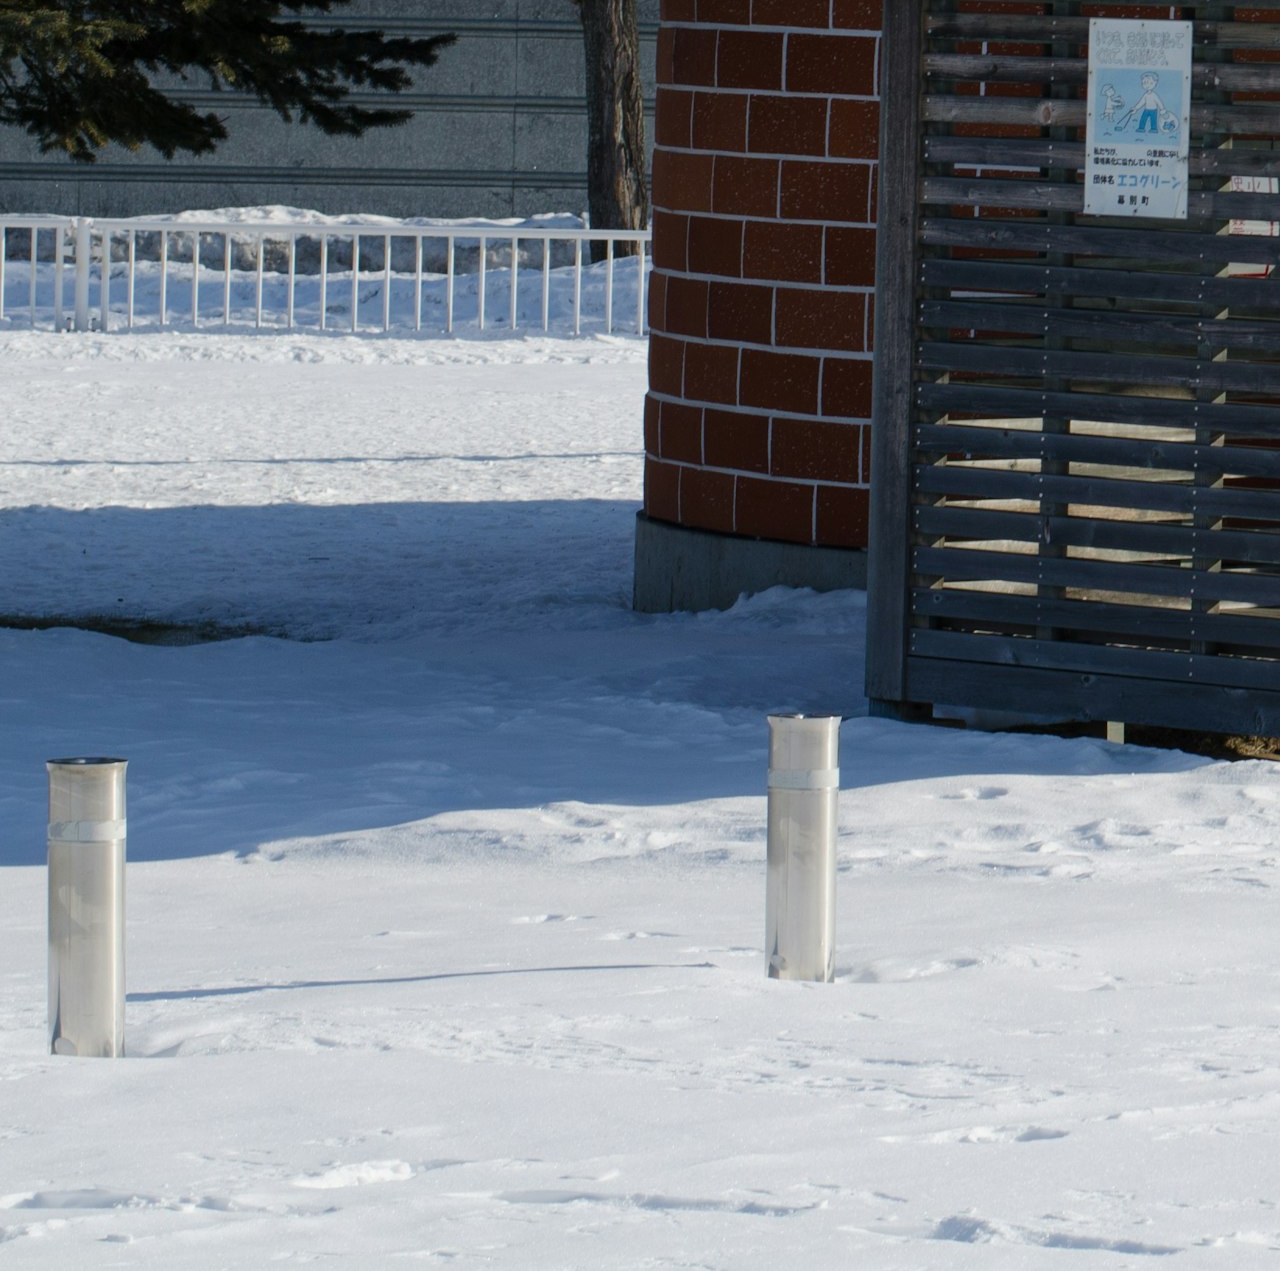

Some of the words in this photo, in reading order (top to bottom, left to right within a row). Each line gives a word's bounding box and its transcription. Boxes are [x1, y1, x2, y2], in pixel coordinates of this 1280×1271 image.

[1092, 174, 1115, 185] 団体名
[1116, 173, 1182, 189] エコグリーン
